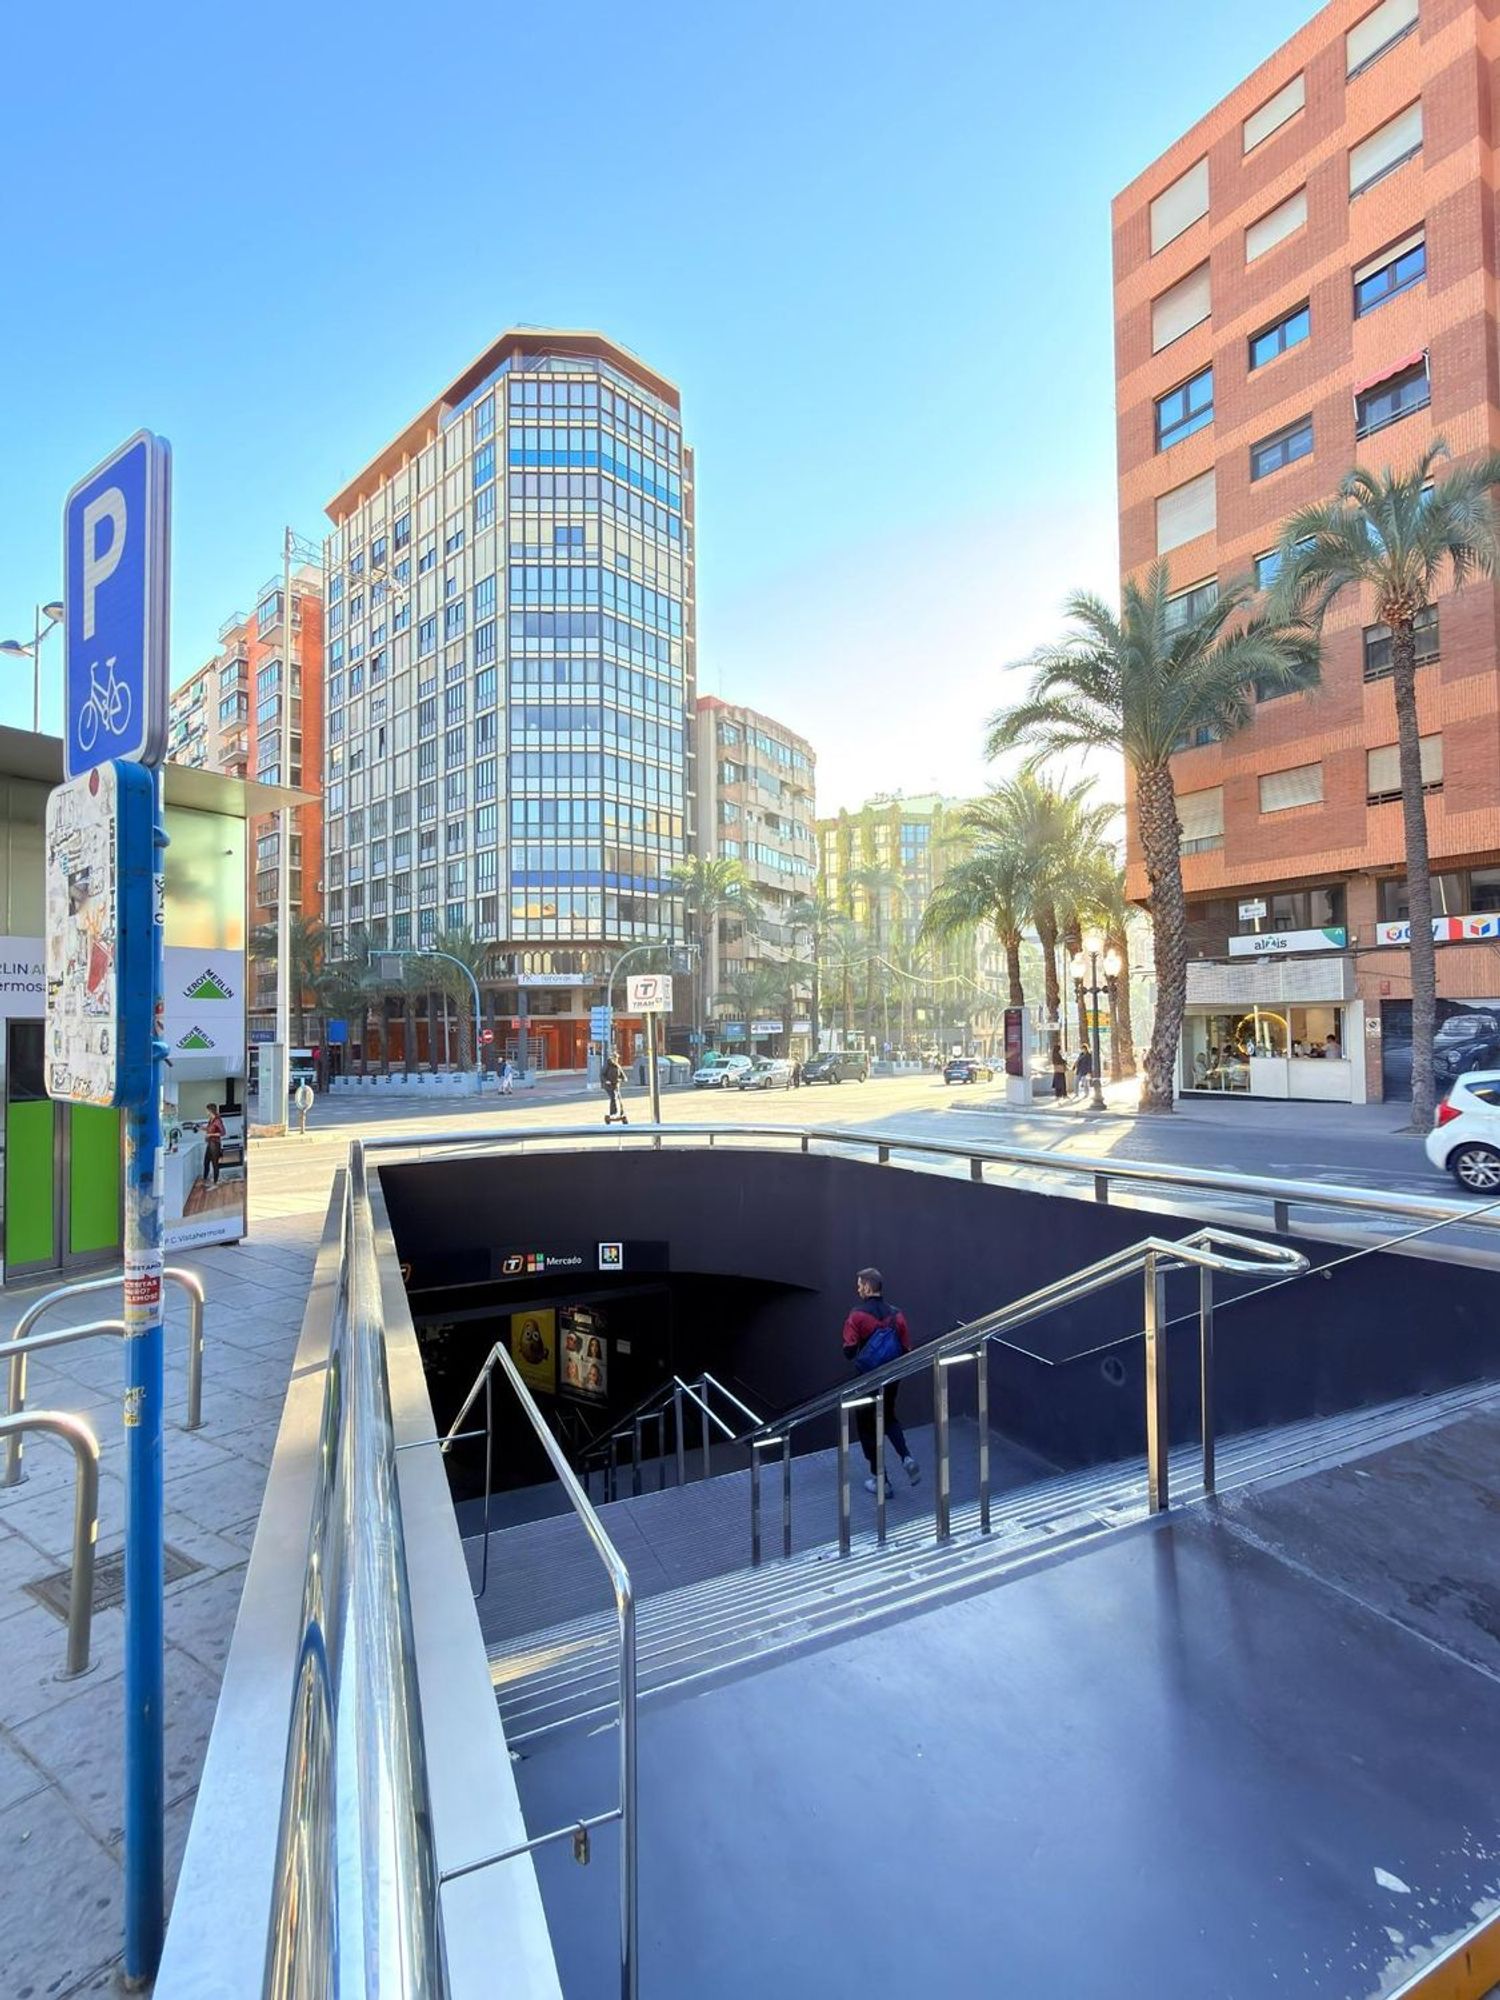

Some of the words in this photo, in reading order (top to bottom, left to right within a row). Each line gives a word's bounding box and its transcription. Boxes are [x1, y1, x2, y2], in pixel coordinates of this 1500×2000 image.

[83, 486, 128, 642] P
[0, 962, 28, 975] LIN
[182, 973, 208, 998] LEROY
[204, 968, 235, 999] MERLIN
[175, 1029, 195, 1049] LEROY
[192, 1025, 216, 1048] MERLIN
[546, 1255, 582, 1267] Mercado
